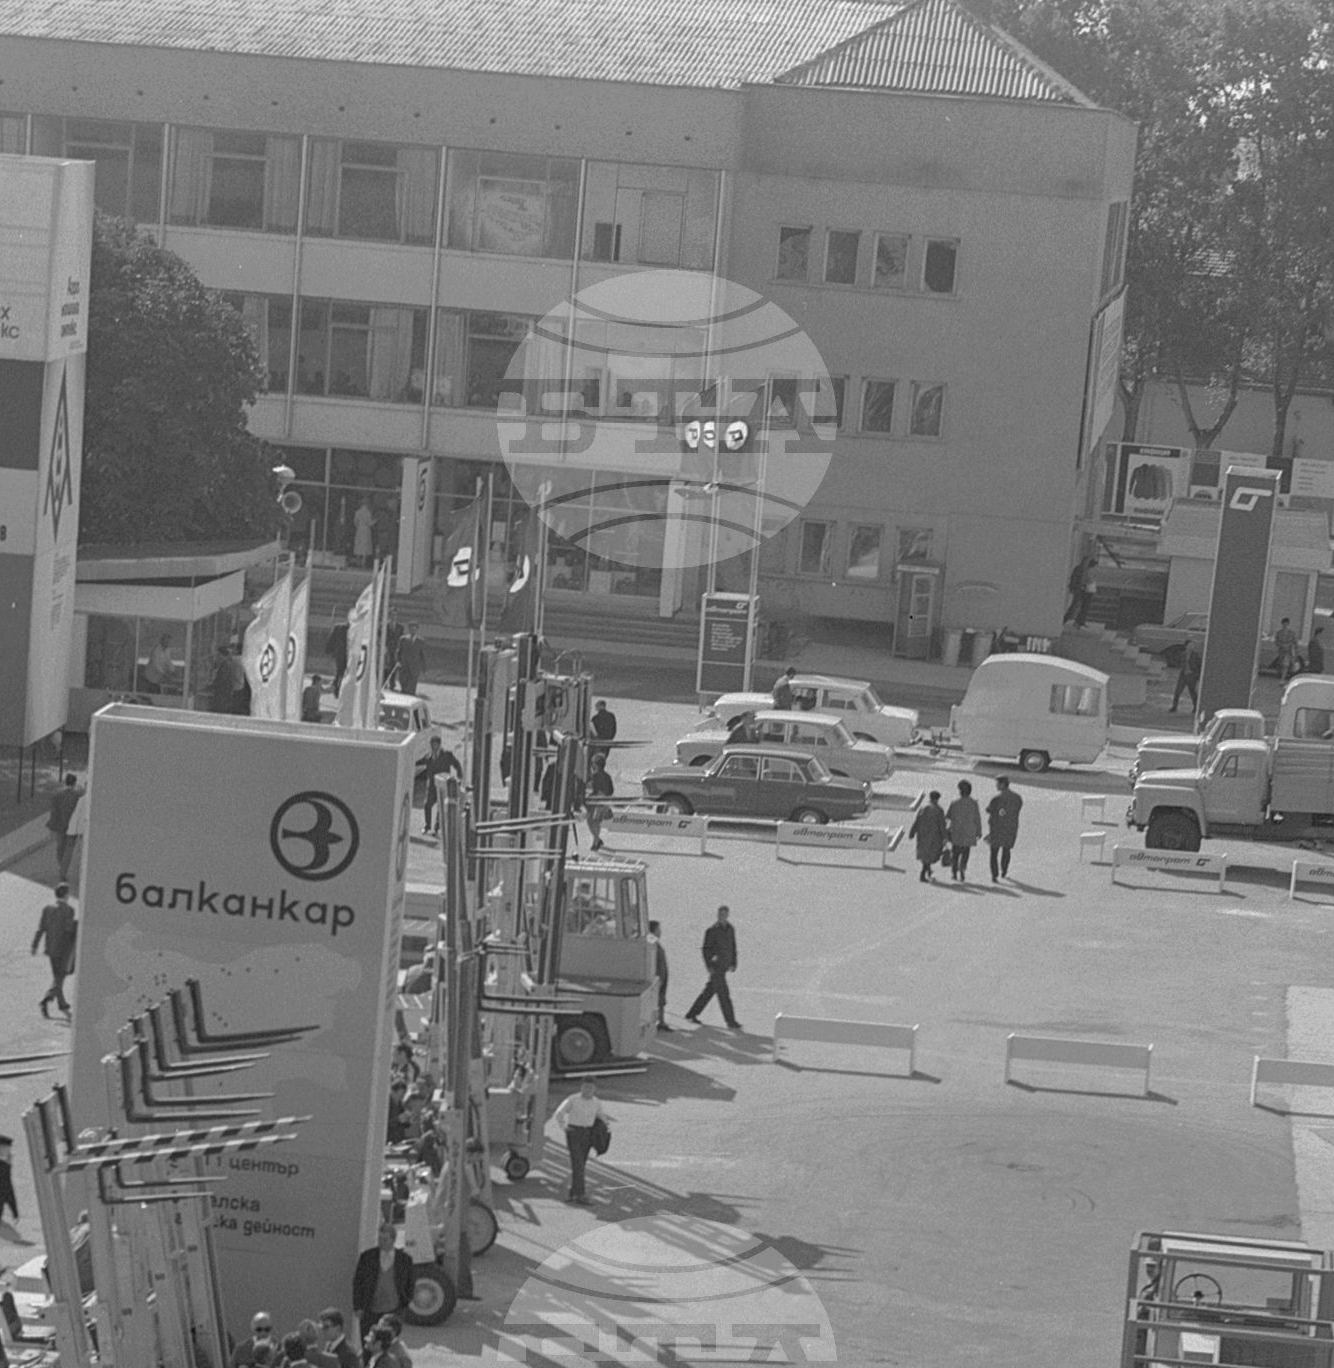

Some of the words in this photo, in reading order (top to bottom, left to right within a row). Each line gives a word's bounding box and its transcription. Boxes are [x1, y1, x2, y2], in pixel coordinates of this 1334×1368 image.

[115, 872, 356, 936] балканкар
[229, 1157, 300, 1178] център
[243, 1218, 316, 1239] дейност
